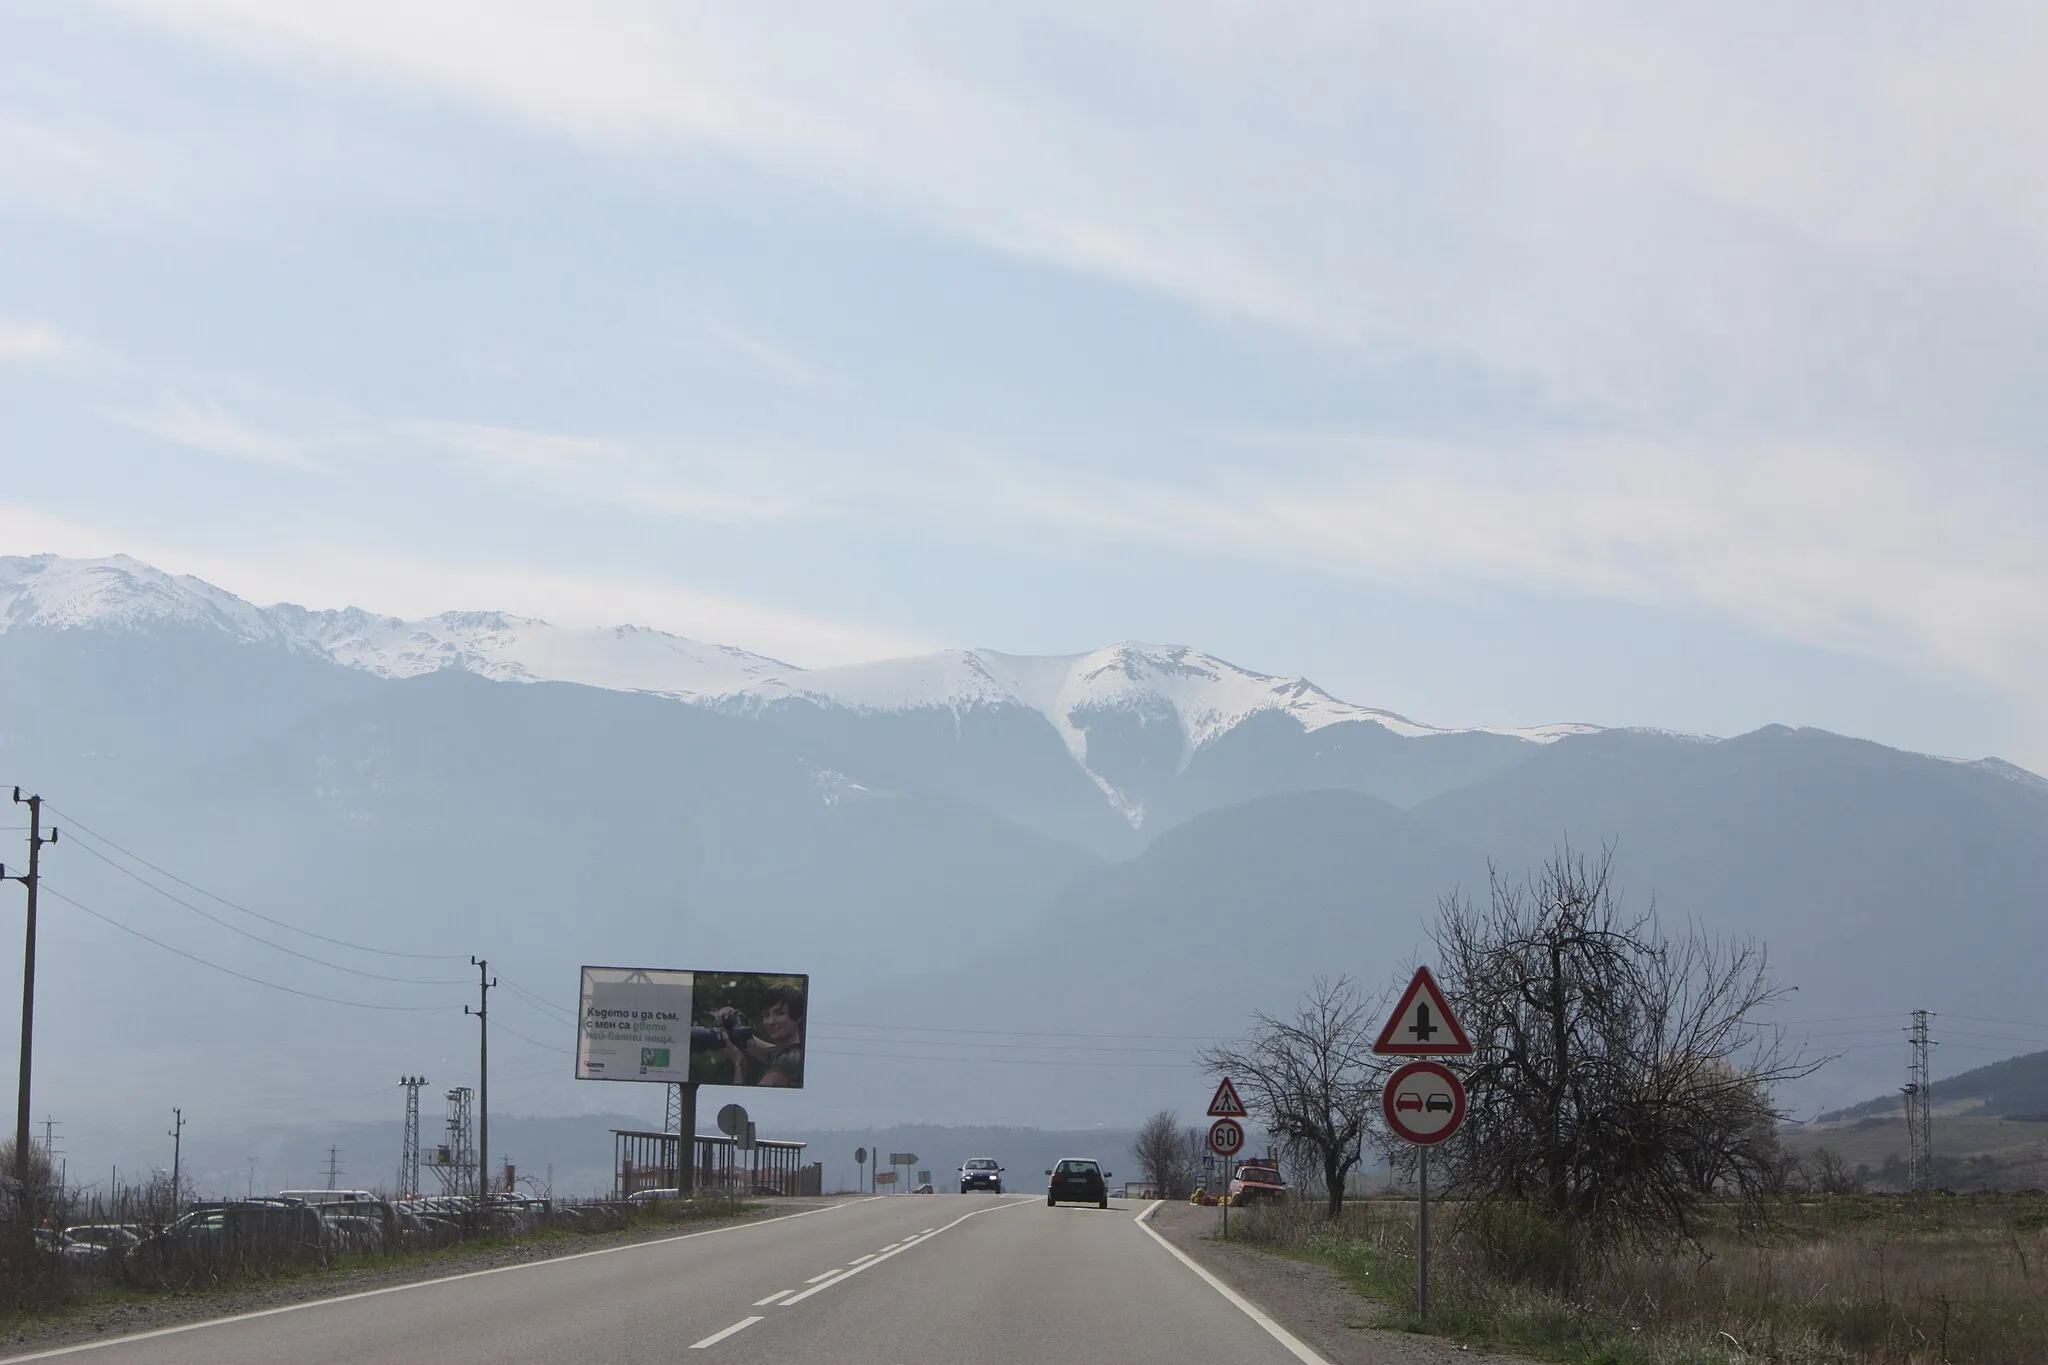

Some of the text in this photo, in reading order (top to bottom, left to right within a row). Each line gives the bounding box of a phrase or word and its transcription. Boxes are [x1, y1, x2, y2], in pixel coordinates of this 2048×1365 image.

[587, 1007, 629, 1019] Където
[640, 1011, 653, 1021] да
[595, 1021, 616, 1029] мен
[1215, 1127, 1237, 1147] 60
